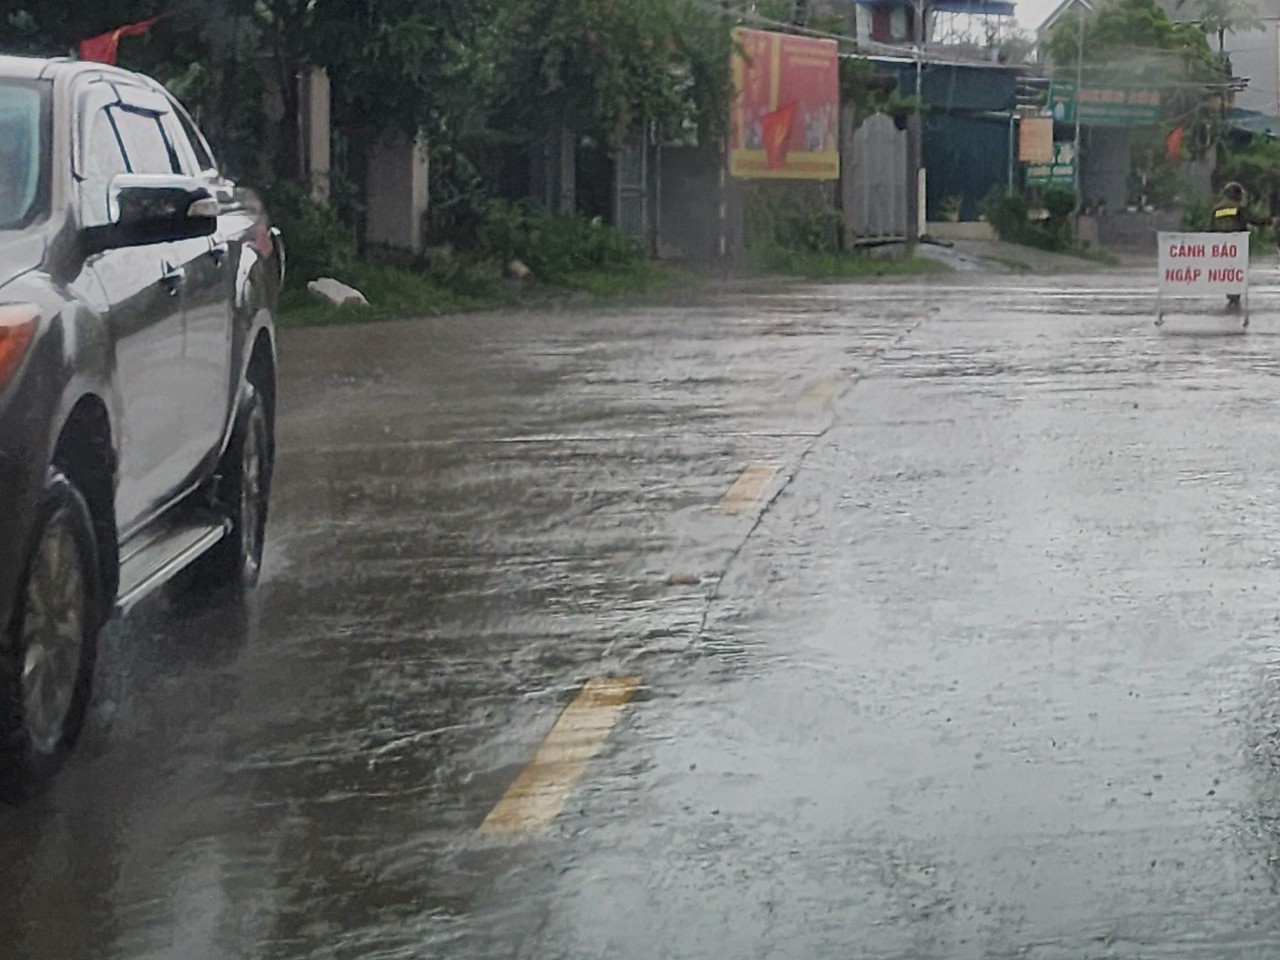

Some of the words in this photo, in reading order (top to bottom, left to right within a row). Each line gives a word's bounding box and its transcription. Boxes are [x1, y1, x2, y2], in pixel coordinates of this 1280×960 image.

[1169, 240, 1205, 258] CẢNH
[1211, 242, 1237, 258] BÁO
[1165, 266, 1201, 285] NGẬP
[1208, 265, 1244, 282] NƯỚC
